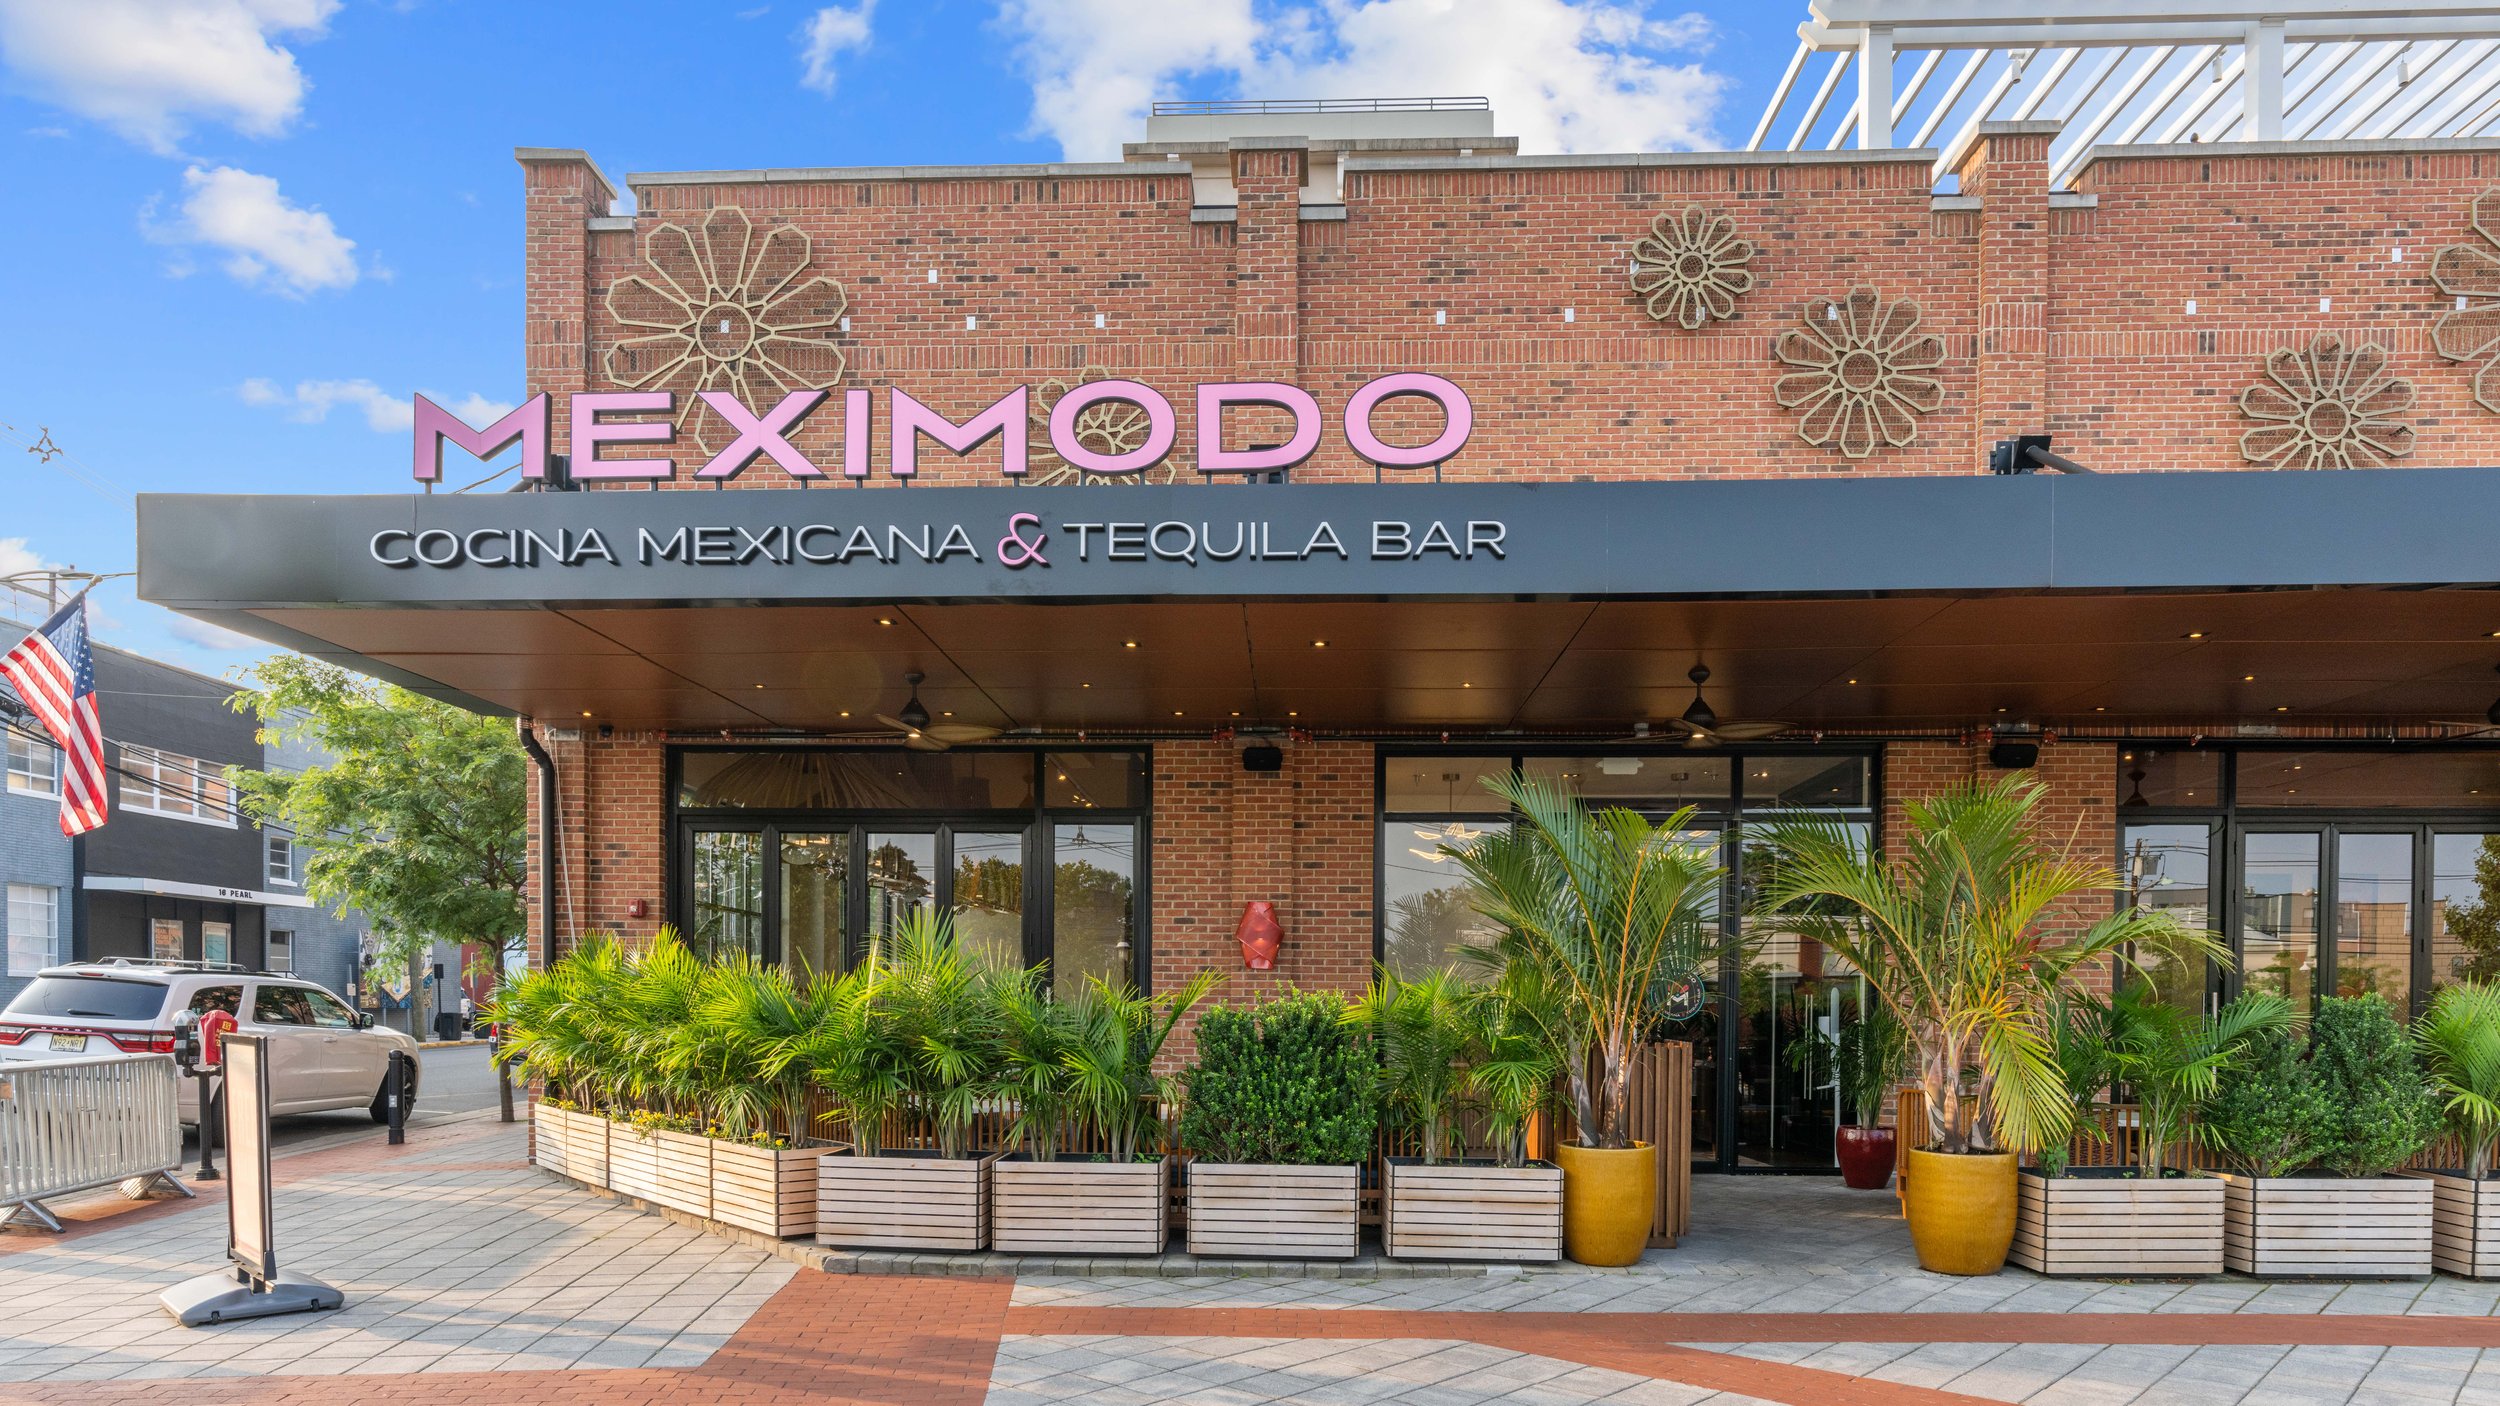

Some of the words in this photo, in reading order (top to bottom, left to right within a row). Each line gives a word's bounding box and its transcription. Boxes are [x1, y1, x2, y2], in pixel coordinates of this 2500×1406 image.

[412, 371, 1474, 483] MEXIMODO
[369, 526, 619, 567] COCINA
[638, 523, 981, 567] MEXICANA
[996, 512, 1050, 568] &
[1062, 519, 1348, 567] TEQUILA
[1370, 519, 1507, 561] BAR
[230, 890, 253, 899] PEARL
